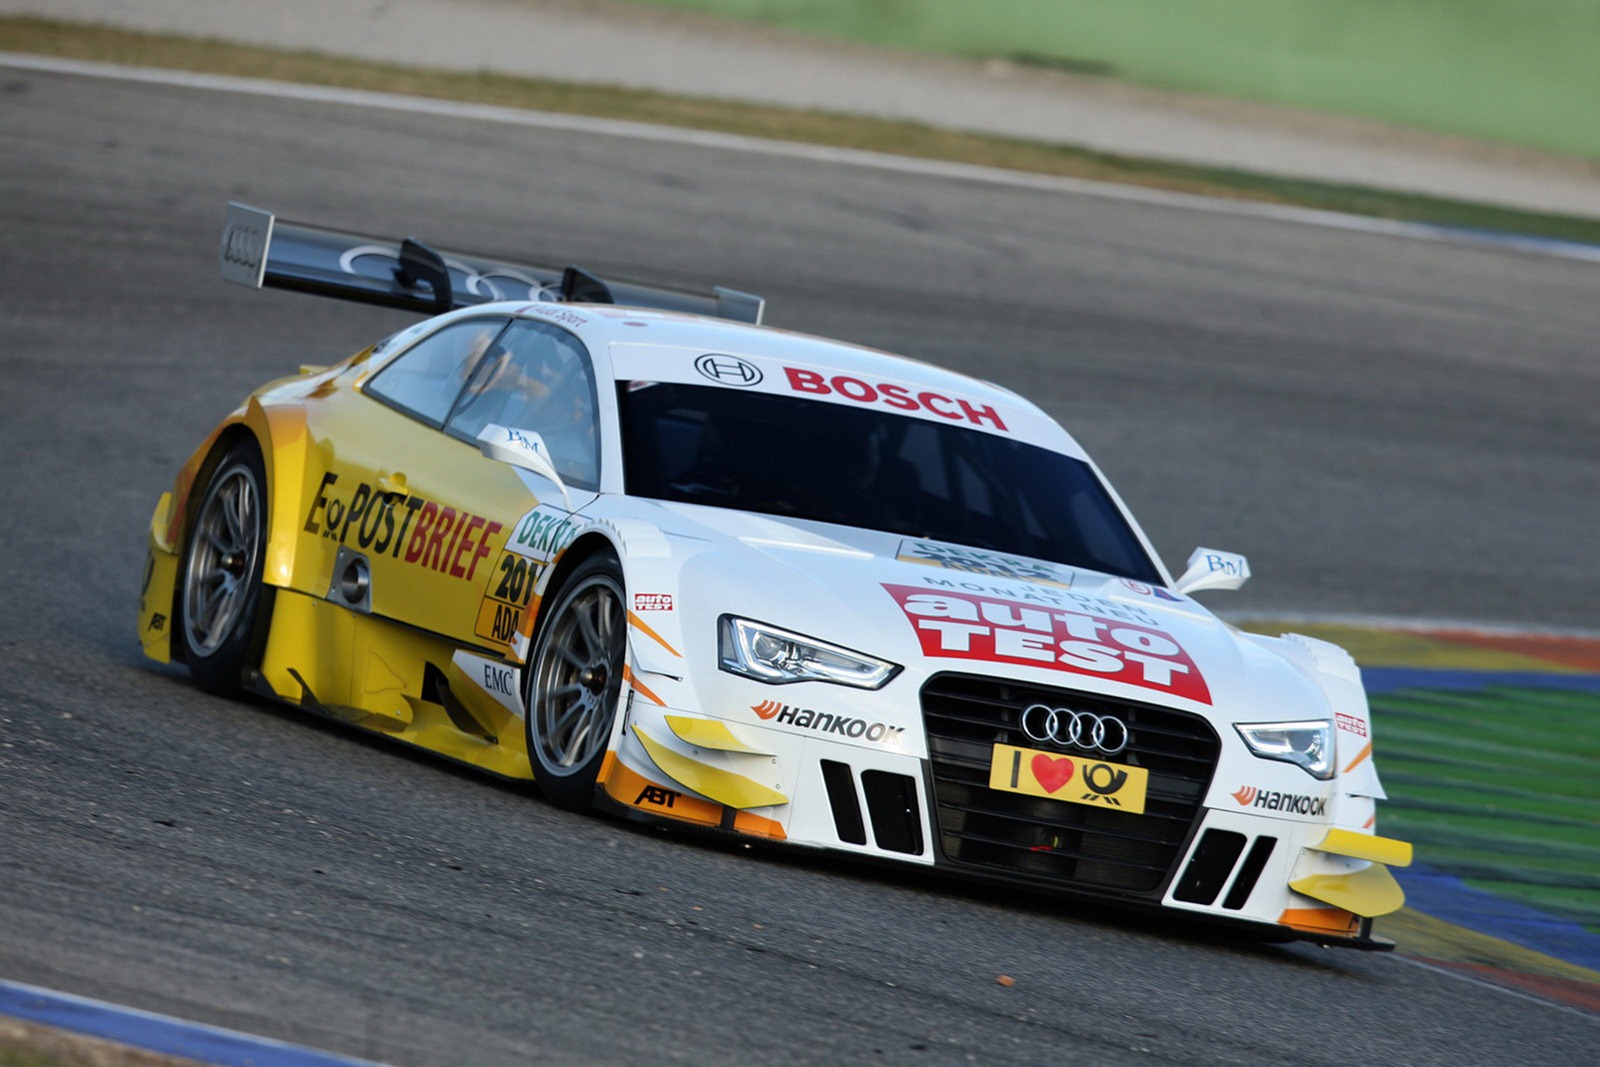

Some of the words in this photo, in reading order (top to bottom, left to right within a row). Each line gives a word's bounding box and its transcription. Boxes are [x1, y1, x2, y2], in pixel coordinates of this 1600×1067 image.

[783, 366, 1009, 432] BOSCH
[635, 594, 671, 604] auto
[922, 576, 1062, 606] MONAT
[1079, 602, 1159, 626] NEU
[1020, 586, 1148, 615] JEDEN
[148, 613, 167, 632] ABT
[904, 594, 1180, 656] auto
[918, 619, 1189, 686] TEST
[1010, 750, 1022, 788] I
[633, 785, 681, 808] ABT
